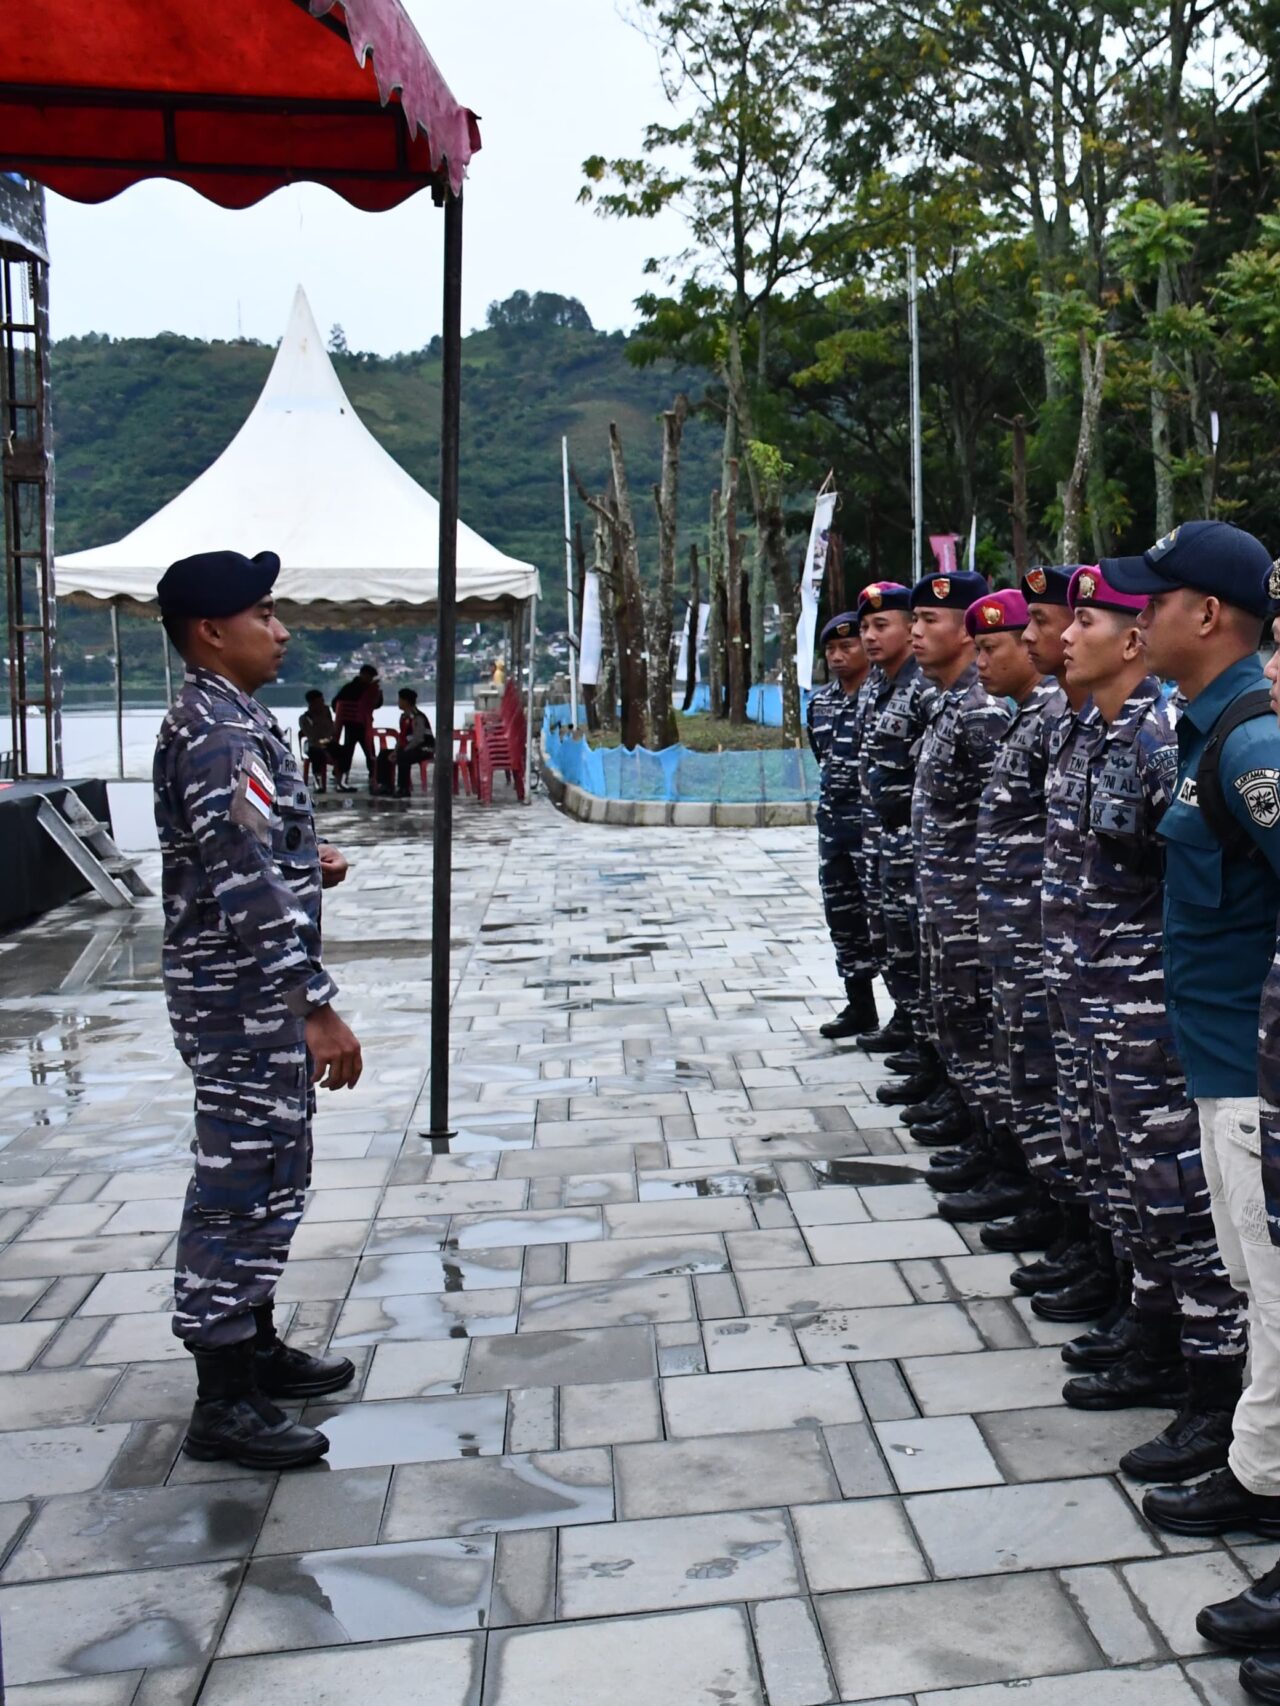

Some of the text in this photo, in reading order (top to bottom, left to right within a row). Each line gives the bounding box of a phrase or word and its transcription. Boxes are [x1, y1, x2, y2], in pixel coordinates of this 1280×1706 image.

[1070, 756, 1086, 770] TNI
[1102, 774, 1138, 794] TNI AL
